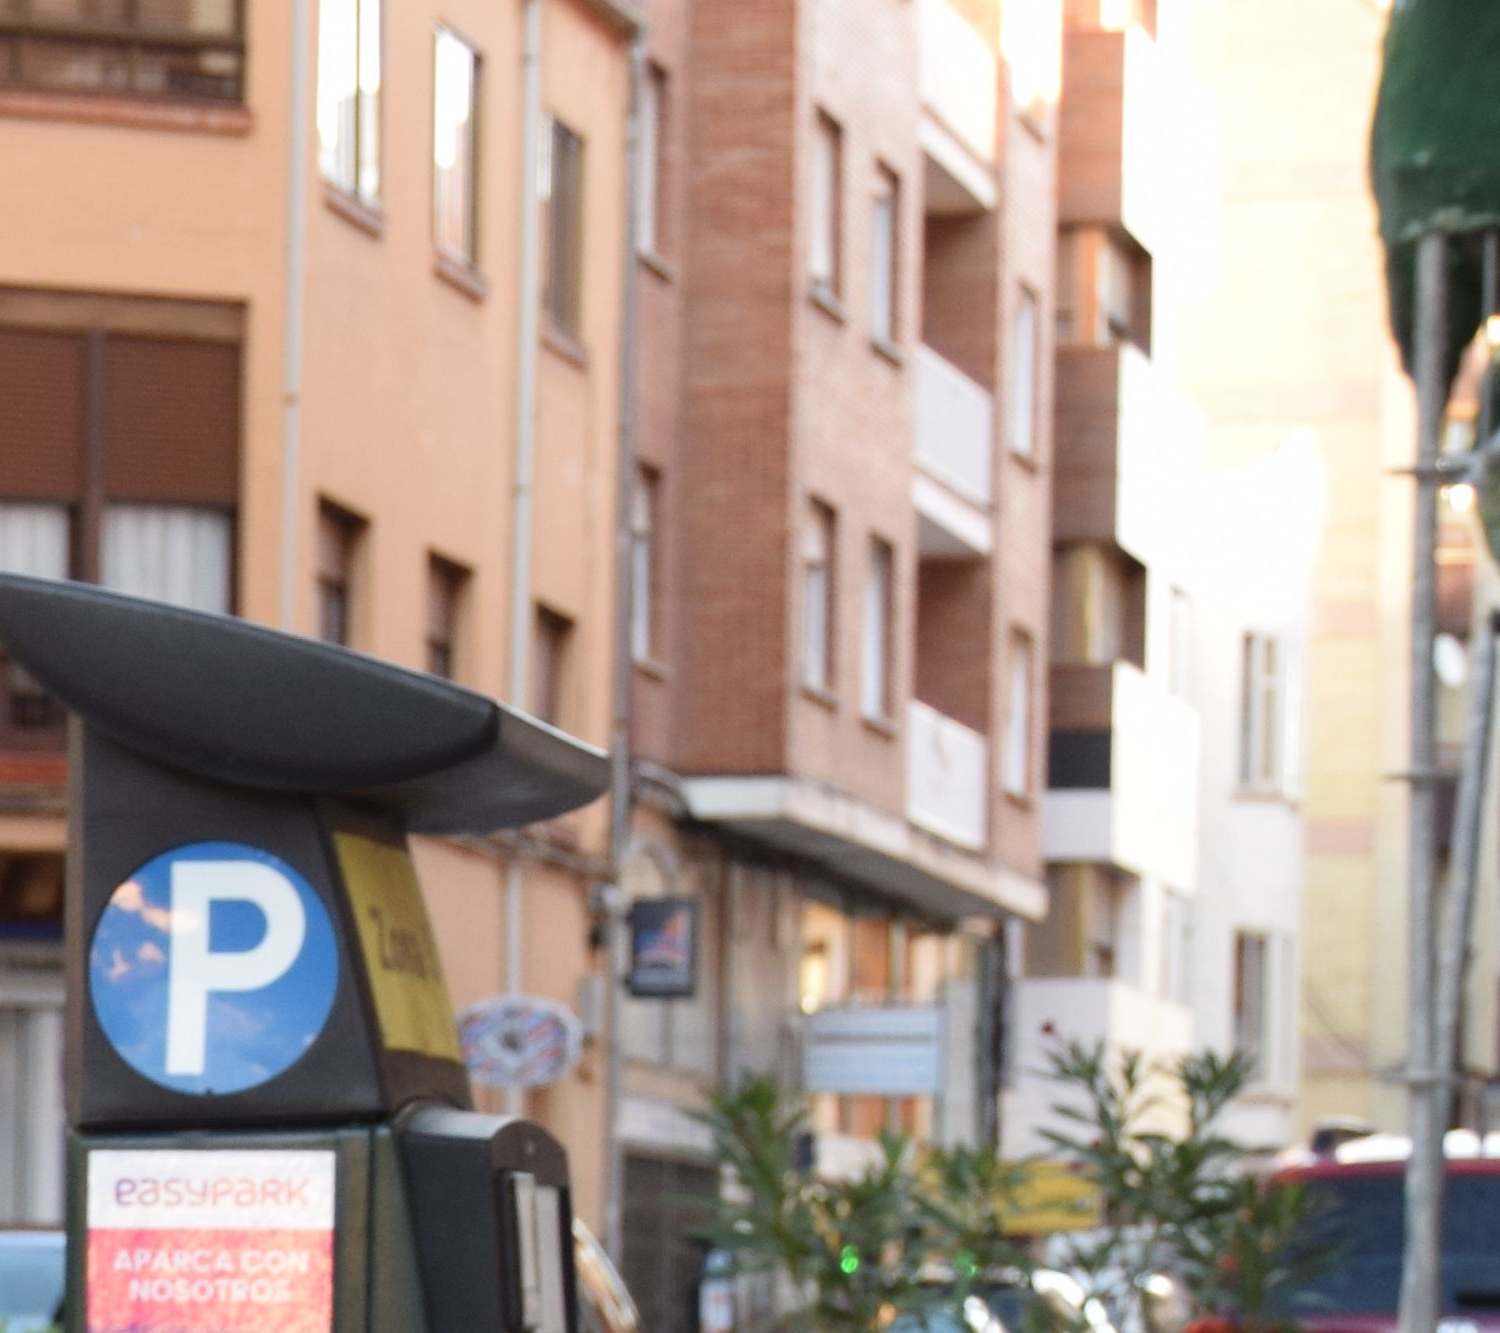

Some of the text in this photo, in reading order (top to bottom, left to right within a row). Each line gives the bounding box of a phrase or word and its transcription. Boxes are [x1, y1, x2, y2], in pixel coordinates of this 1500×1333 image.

[164, 860, 306, 1074] P
[113, 1249, 309, 1274] APARCA CON
[129, 1279, 292, 1303] NOSOTROS
